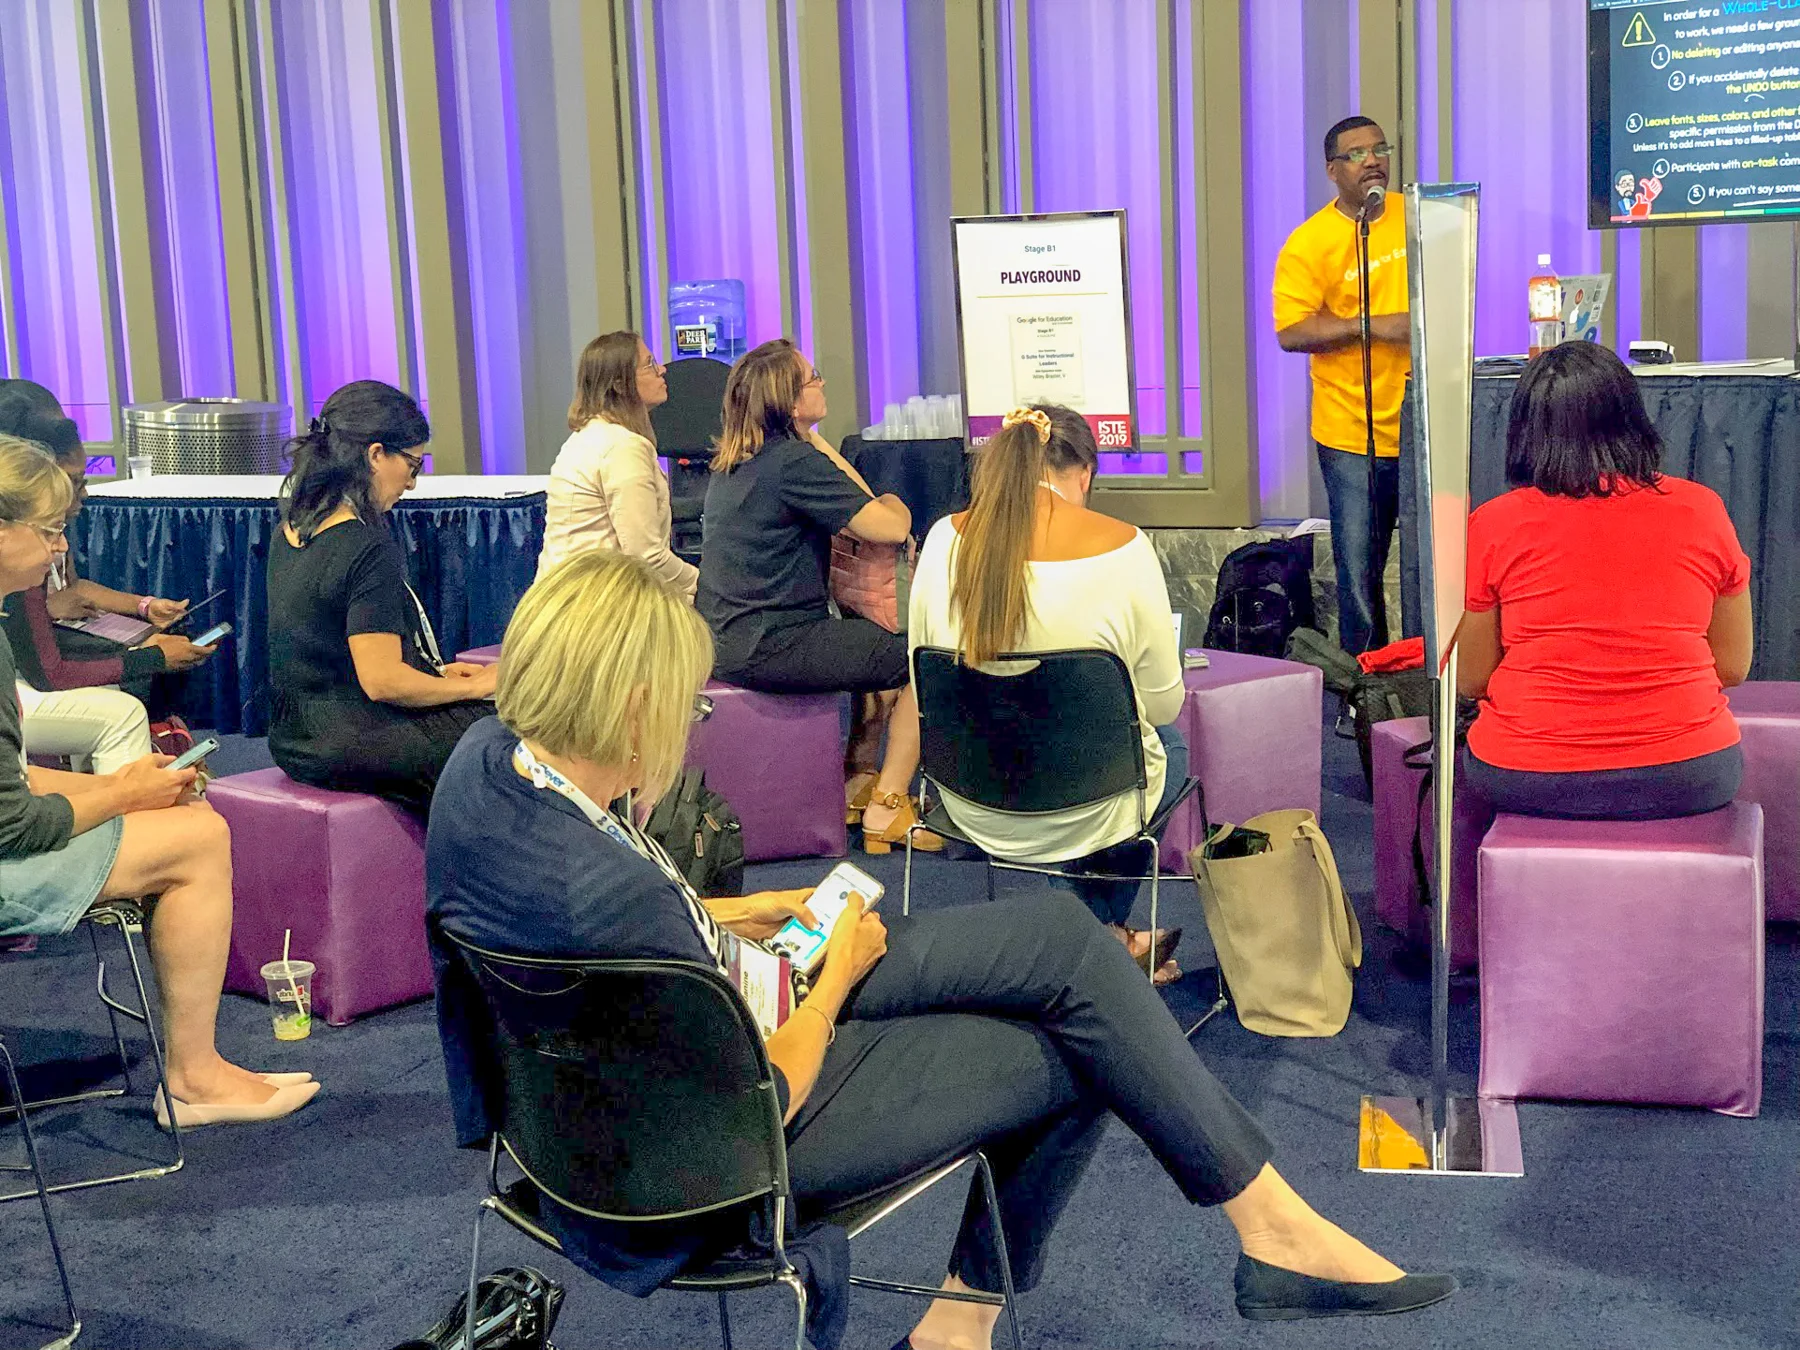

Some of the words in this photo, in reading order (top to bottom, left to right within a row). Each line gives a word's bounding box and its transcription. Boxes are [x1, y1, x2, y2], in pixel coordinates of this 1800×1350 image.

[1664, 12, 1672, 21] In
[1673, 10, 1697, 20] order
[1698, 8, 1712, 18] for
[1712, 8, 1720, 16] a
[1675, 29, 1686, 38] to
[1686, 26, 1710, 38] work,
[1711, 27, 1724, 35] we
[1726, 22, 1748, 34] need
[1749, 23, 1756, 32] a
[1757, 20, 1774, 31] few
[1672, 50, 1684, 60] No
[1684, 47, 1721, 58] deleting
[1722, 46, 1732, 55] or
[1734, 42, 1766, 54] editing
[1688, 74, 1696, 84] If
[1696, 75, 1712, 86] you
[1714, 68, 1769, 82] accidentally
[1770, 66, 1799, 78] delete
[1726, 84, 1742, 94] the
[1742, 82, 1769, 93] UNDO
[1645, 118, 1670, 127] Leave
[1672, 114, 1696, 124] fonts,
[1696, 113, 1720, 123] sizes,
[1721, 110, 1750, 121] colors,
[1752, 107, 1770, 118] and
[1770, 106, 1796, 117] other
[1669, 126, 1702, 140] specific
[1703, 124, 1752, 138] permission
[1753, 122, 1776, 132] from
[1776, 120, 1793, 130] the
[1633, 143, 1657, 152] Unless
[1658, 142, 1668, 150] it's
[1670, 141, 1678, 149] to
[1678, 140, 1694, 149] add
[1694, 140, 1714, 148] more
[1716, 137, 1734, 146] lines
[1734, 136, 1744, 145] to
[1750, 134, 1784, 144] filled-up
[1672, 160, 1720, 174] Participate
[1721, 158, 1740, 170] with
[1742, 156, 1778, 168] on-task
[1708, 186, 1716, 197] If
[1716, 187, 1732, 198] you
[1734, 184, 1756, 196] can't
[1758, 186, 1774, 196] say
[1024, 245, 1045, 254] Stage
[1000, 269, 1081, 284] PLAYGROUND
[1098, 421, 1127, 434] ISTE
[1098, 434, 1127, 445] 2019
